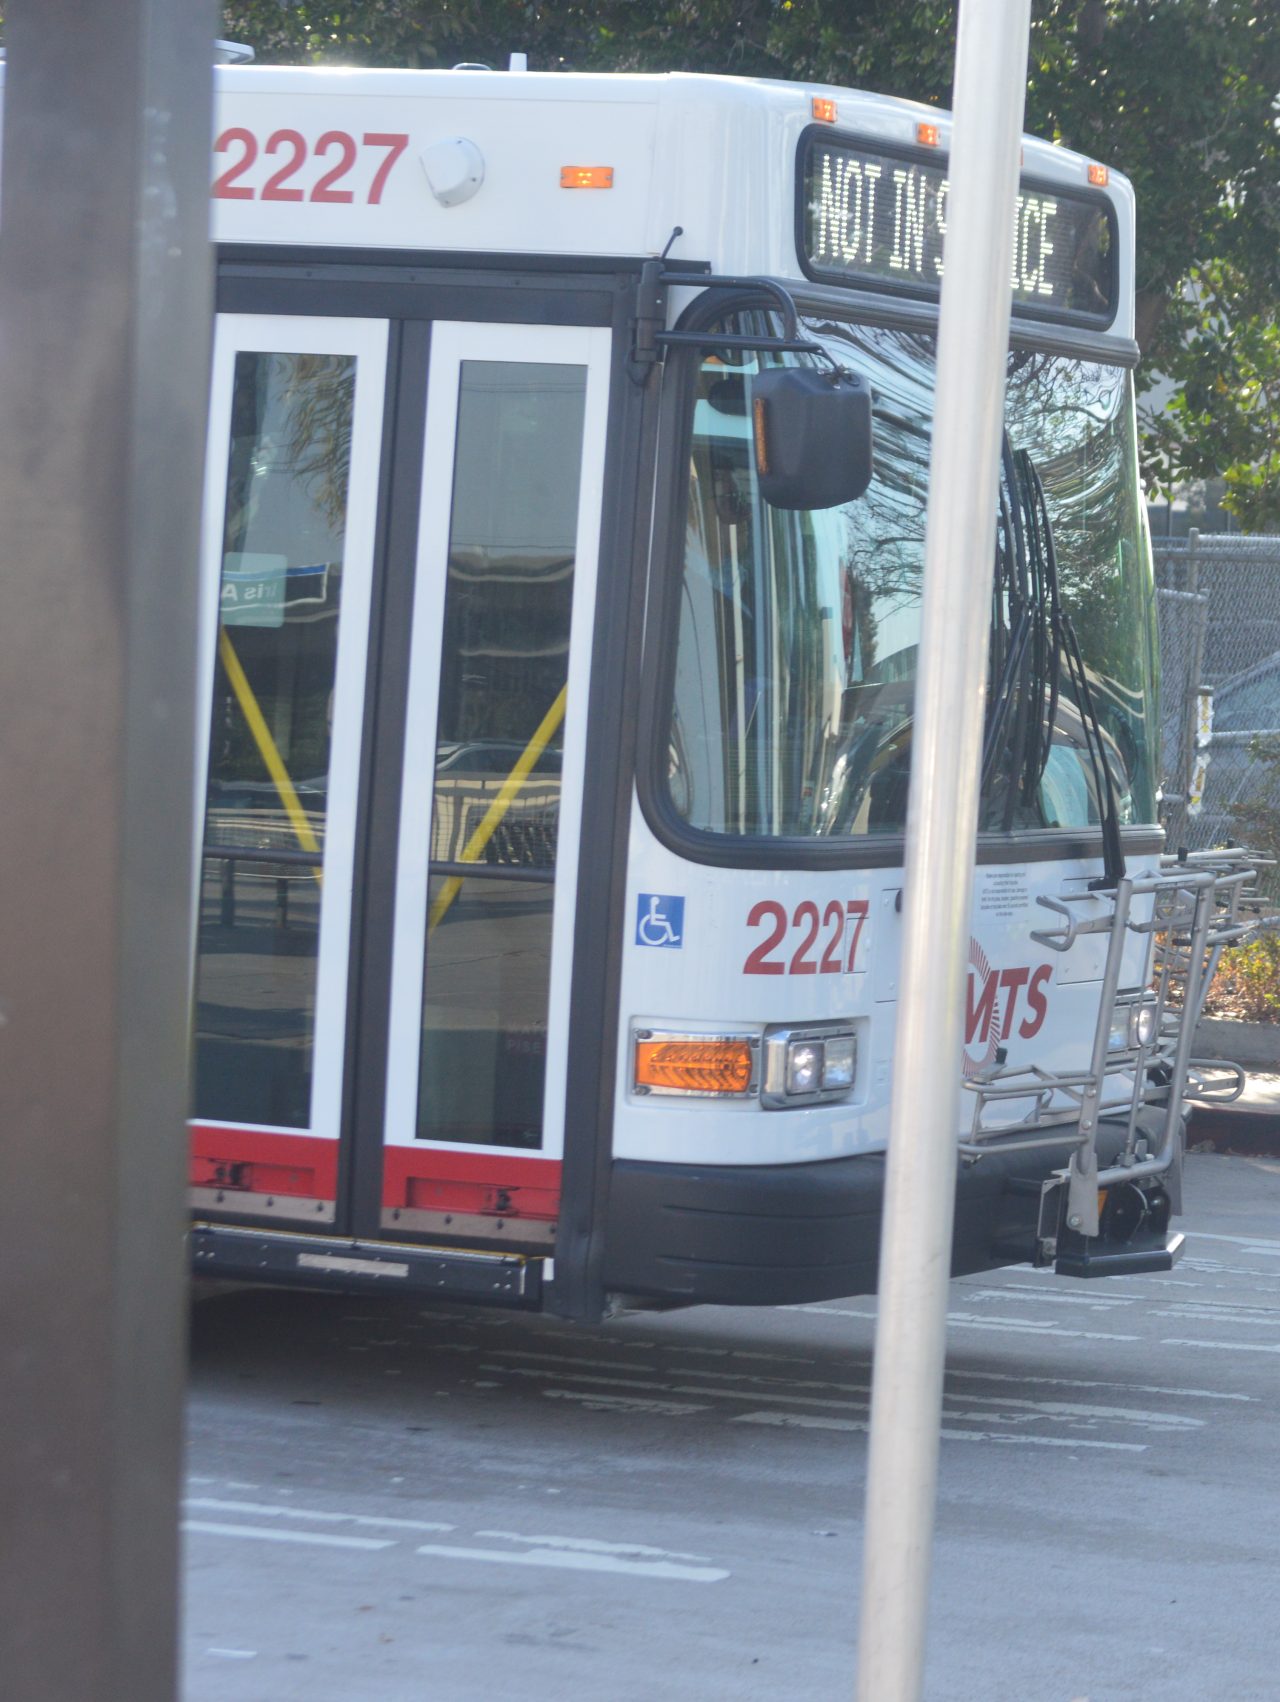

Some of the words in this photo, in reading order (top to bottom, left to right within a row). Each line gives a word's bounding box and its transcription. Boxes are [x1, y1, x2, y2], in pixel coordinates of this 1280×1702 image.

[212, 127, 409, 205] 2227
[819, 154, 881, 264] NOT
[889, 170, 926, 272] IN
[934, 180, 1057, 295] SICE
[742, 899, 870, 976] 2227
[964, 963, 1053, 1044] MTS
